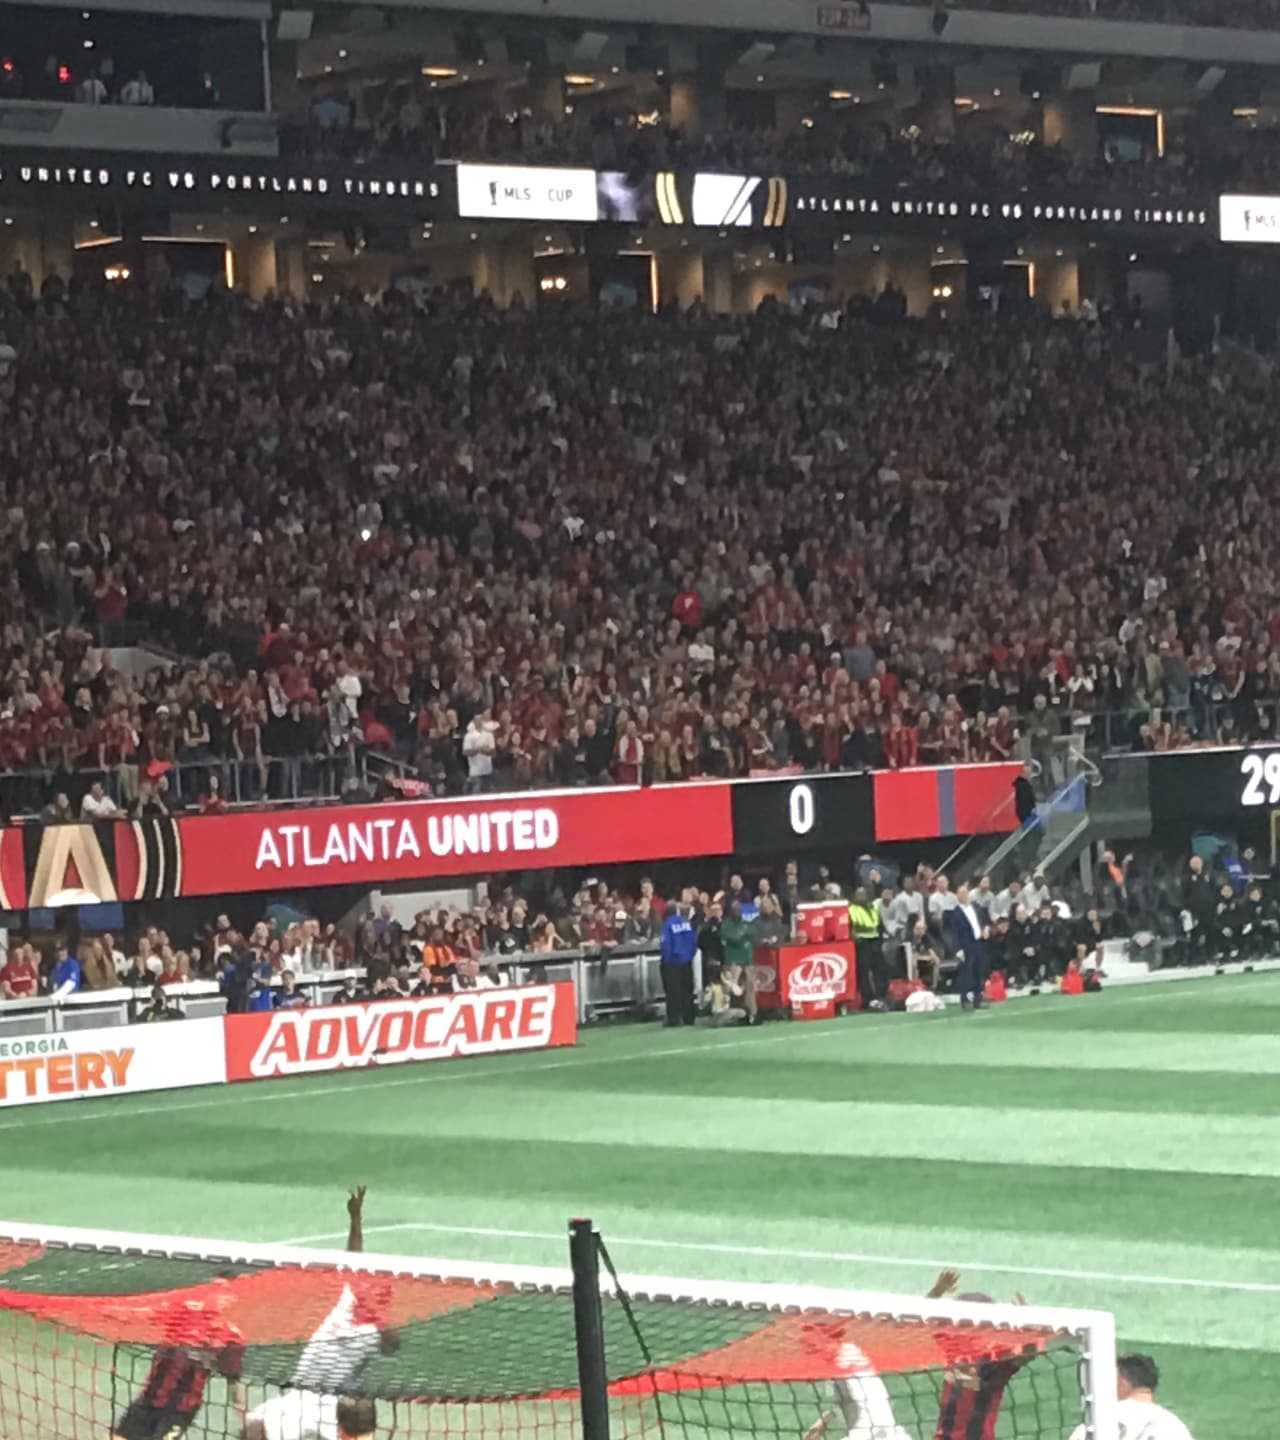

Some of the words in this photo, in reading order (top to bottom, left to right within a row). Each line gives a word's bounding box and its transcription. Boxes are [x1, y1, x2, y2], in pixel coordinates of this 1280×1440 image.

[21, 167, 109, 185] UNITED
[127, 171, 152, 186] FC
[169, 172, 194, 189] VS
[211, 174, 327, 193] PORTLAND
[344, 179, 438, 197] TIMBERS
[504, 186, 532, 201] MLS
[548, 189, 573, 202] CUP
[796, 197, 879, 212] ATLANTA
[789, 783, 815, 835] 0
[255, 818, 420, 870] ATLANTA
[428, 809, 559, 857] UNITED
[257, 992, 551, 1068] ADVOCARE
